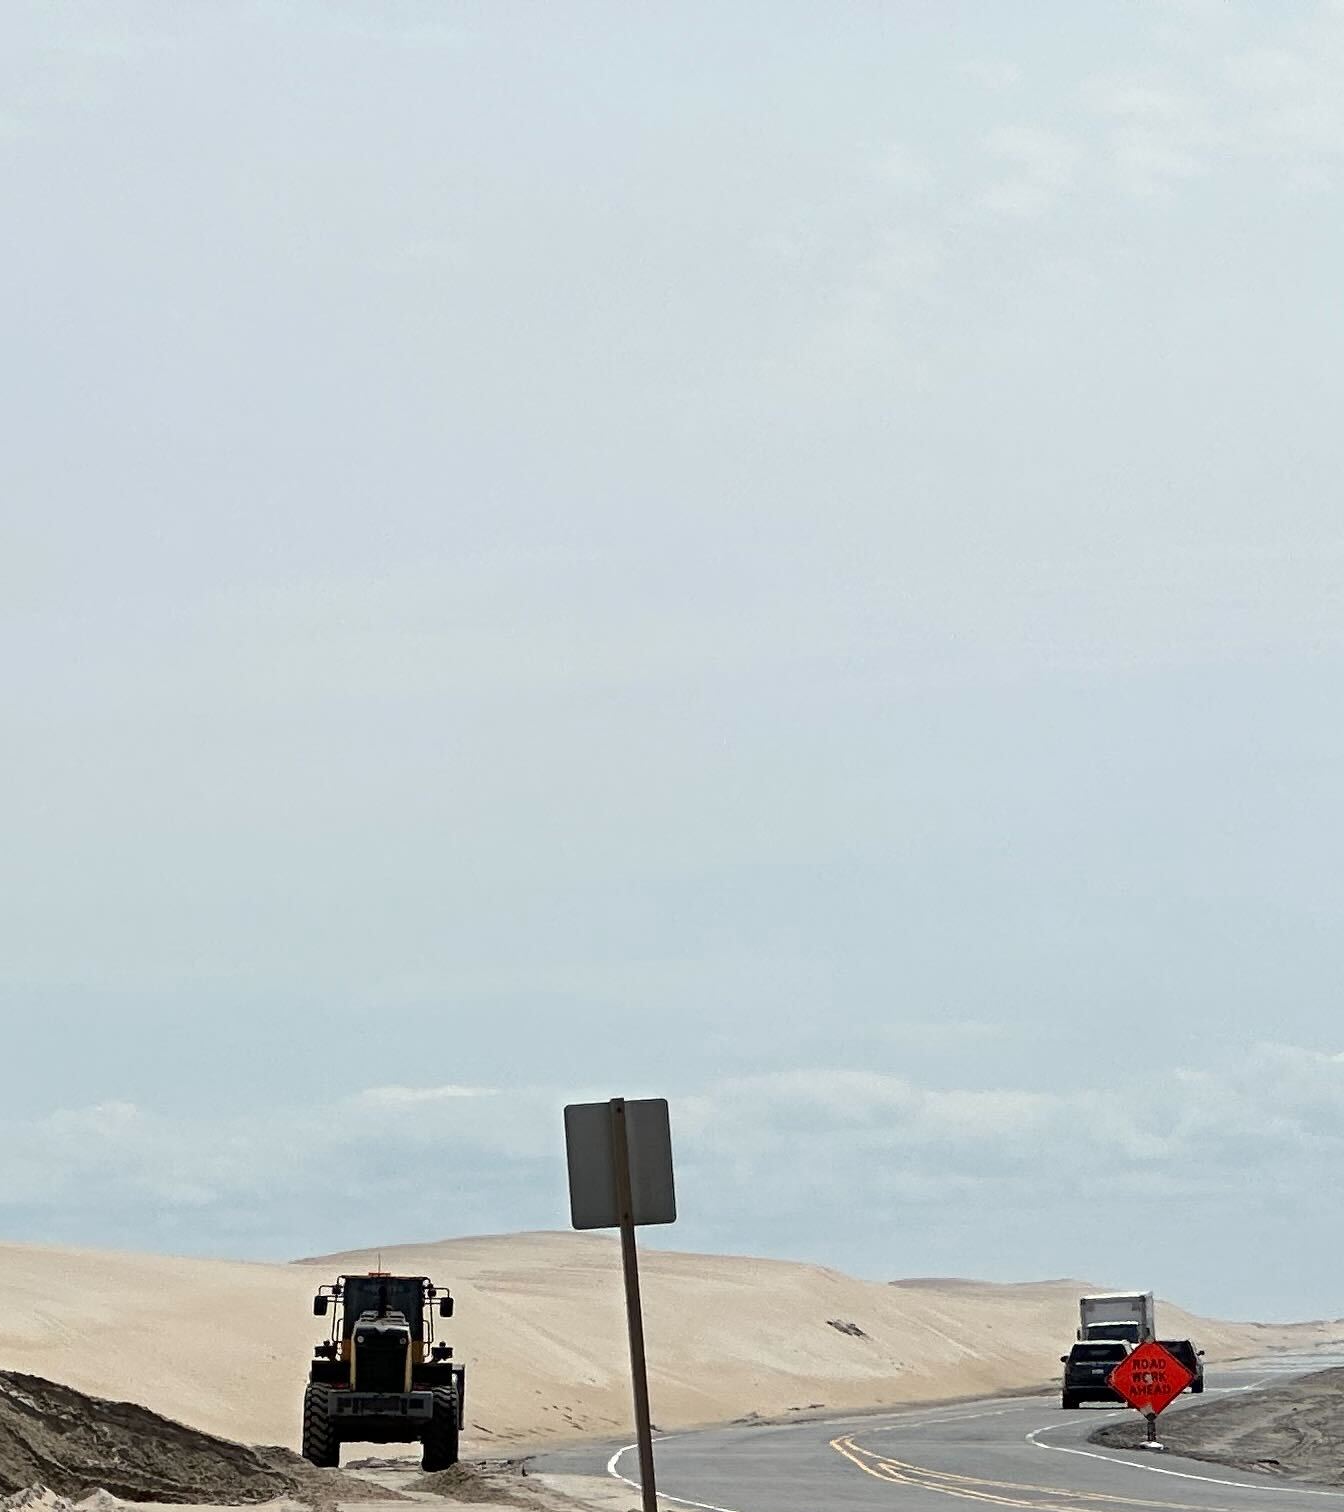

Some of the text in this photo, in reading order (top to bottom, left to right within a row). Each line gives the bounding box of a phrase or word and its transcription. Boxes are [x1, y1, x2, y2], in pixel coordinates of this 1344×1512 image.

[1132, 1359, 1167, 1370] ROAD
[1132, 1371, 1168, 1382] WORK
[1129, 1383, 1172, 1395] AHEAD
